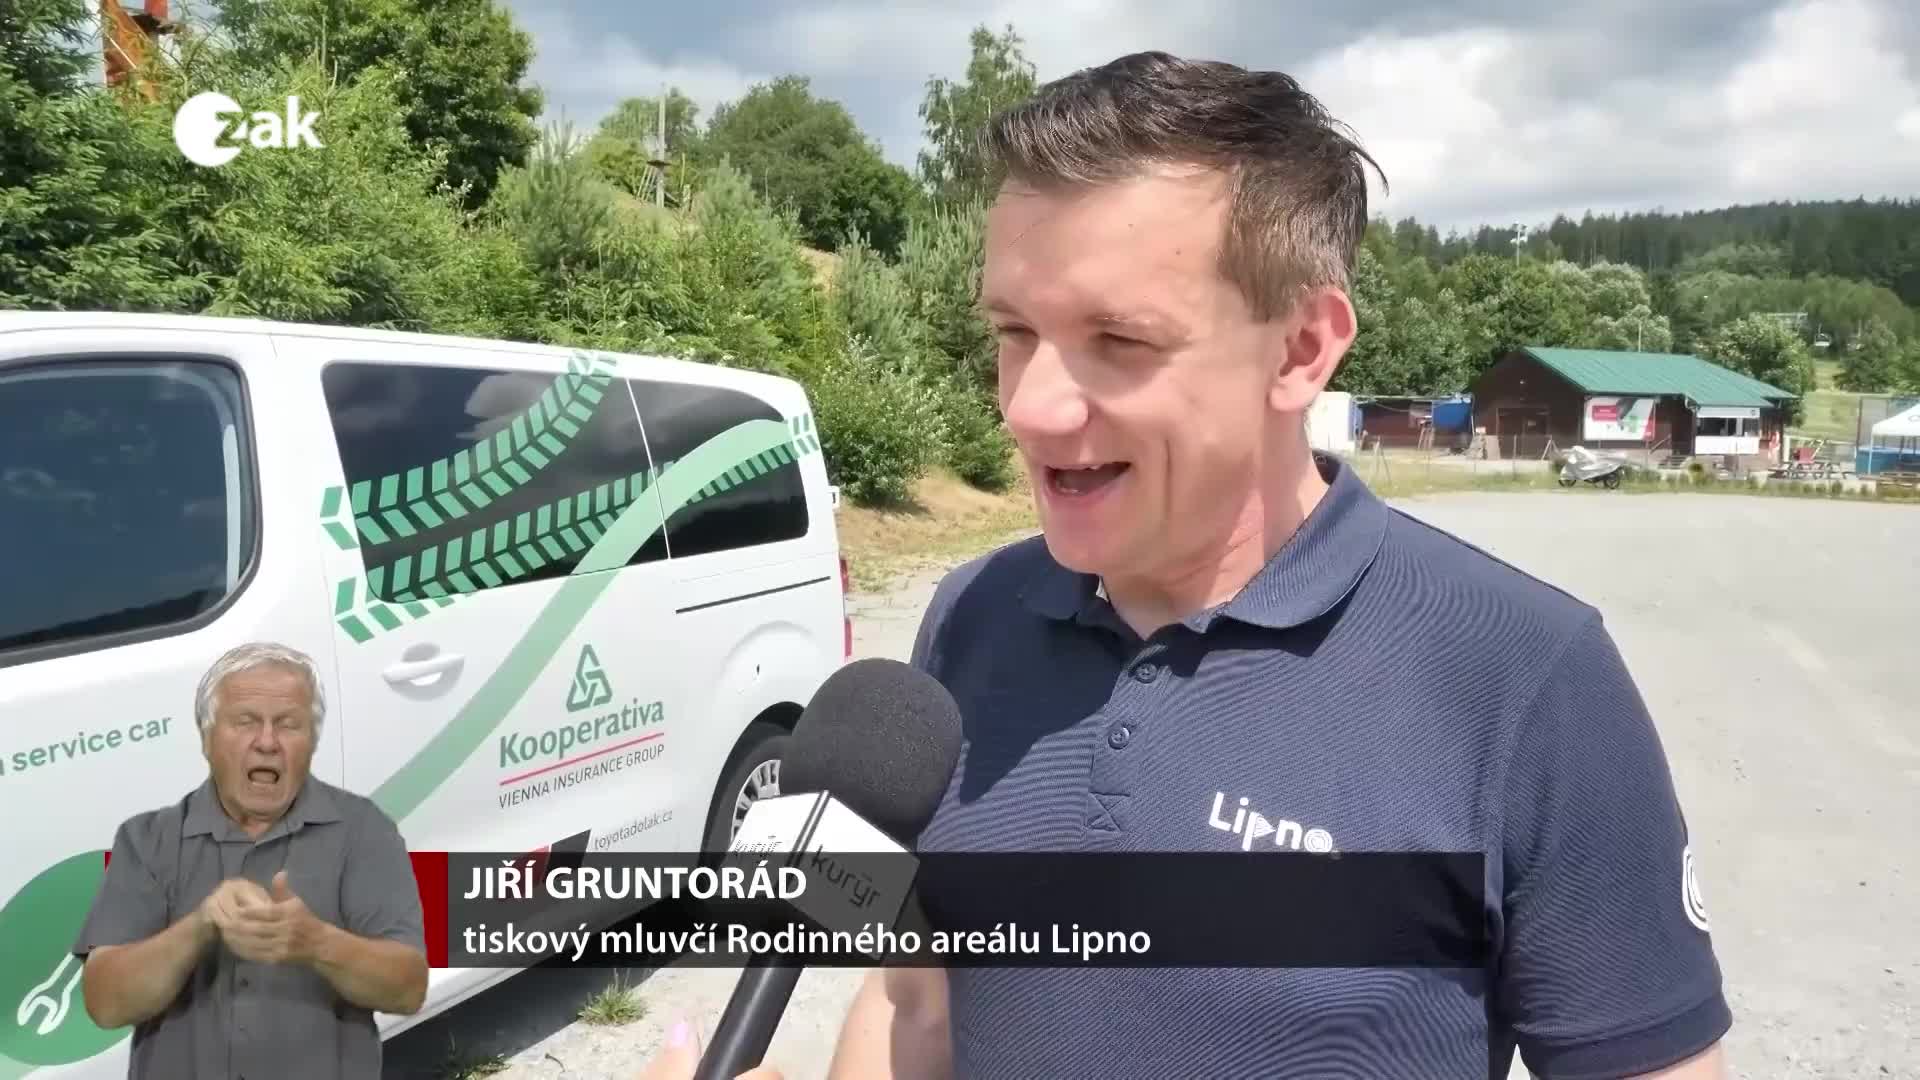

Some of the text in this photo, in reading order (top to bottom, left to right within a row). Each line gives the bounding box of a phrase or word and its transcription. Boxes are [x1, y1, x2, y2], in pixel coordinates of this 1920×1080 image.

[12, 731, 122, 772] service
[128, 717, 172, 742] car
[500, 698, 664, 768] Kooperativa
[499, 744, 665, 809] VIENNA INSURANCE GROUP
[594, 810, 672, 850] toyotadolak.cz
[1208, 791, 1334, 854] Lipno
